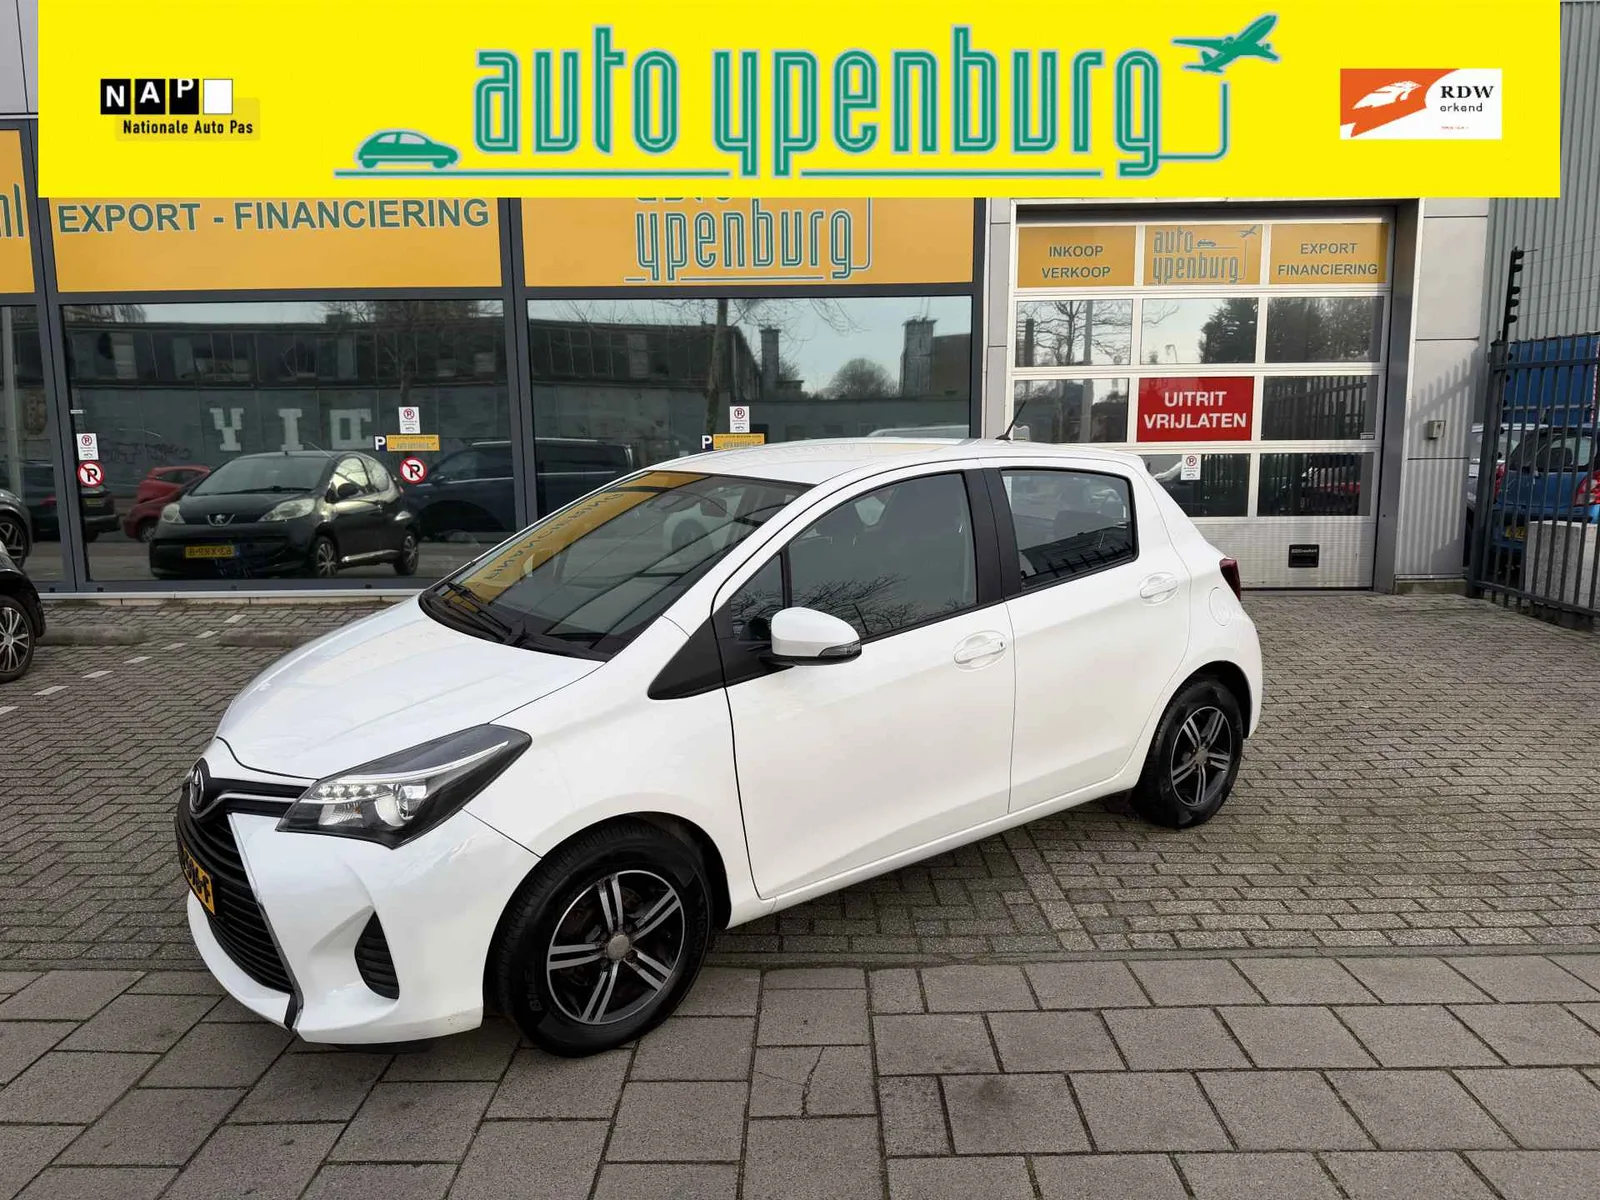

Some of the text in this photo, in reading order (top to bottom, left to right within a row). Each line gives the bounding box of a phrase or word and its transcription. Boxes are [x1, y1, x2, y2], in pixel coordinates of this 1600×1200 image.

[58, 203, 200, 232] EXPORT
[234, 199, 489, 230] FINANCIERING
[636, 198, 852, 281] ypenburg
[1153, 226, 1194, 253] auto
[1048, 245, 1104, 257] INKOOP
[1300, 242, 1358, 254] EXPORT
[1041, 266, 1111, 279] VERKOOP
[1153, 251, 1239, 284] ypenburg
[1278, 263, 1379, 275] FINANCIERING
[1164, 391, 1227, 407] UITRIT
[1144, 413, 1247, 429] VRIJLATEN
